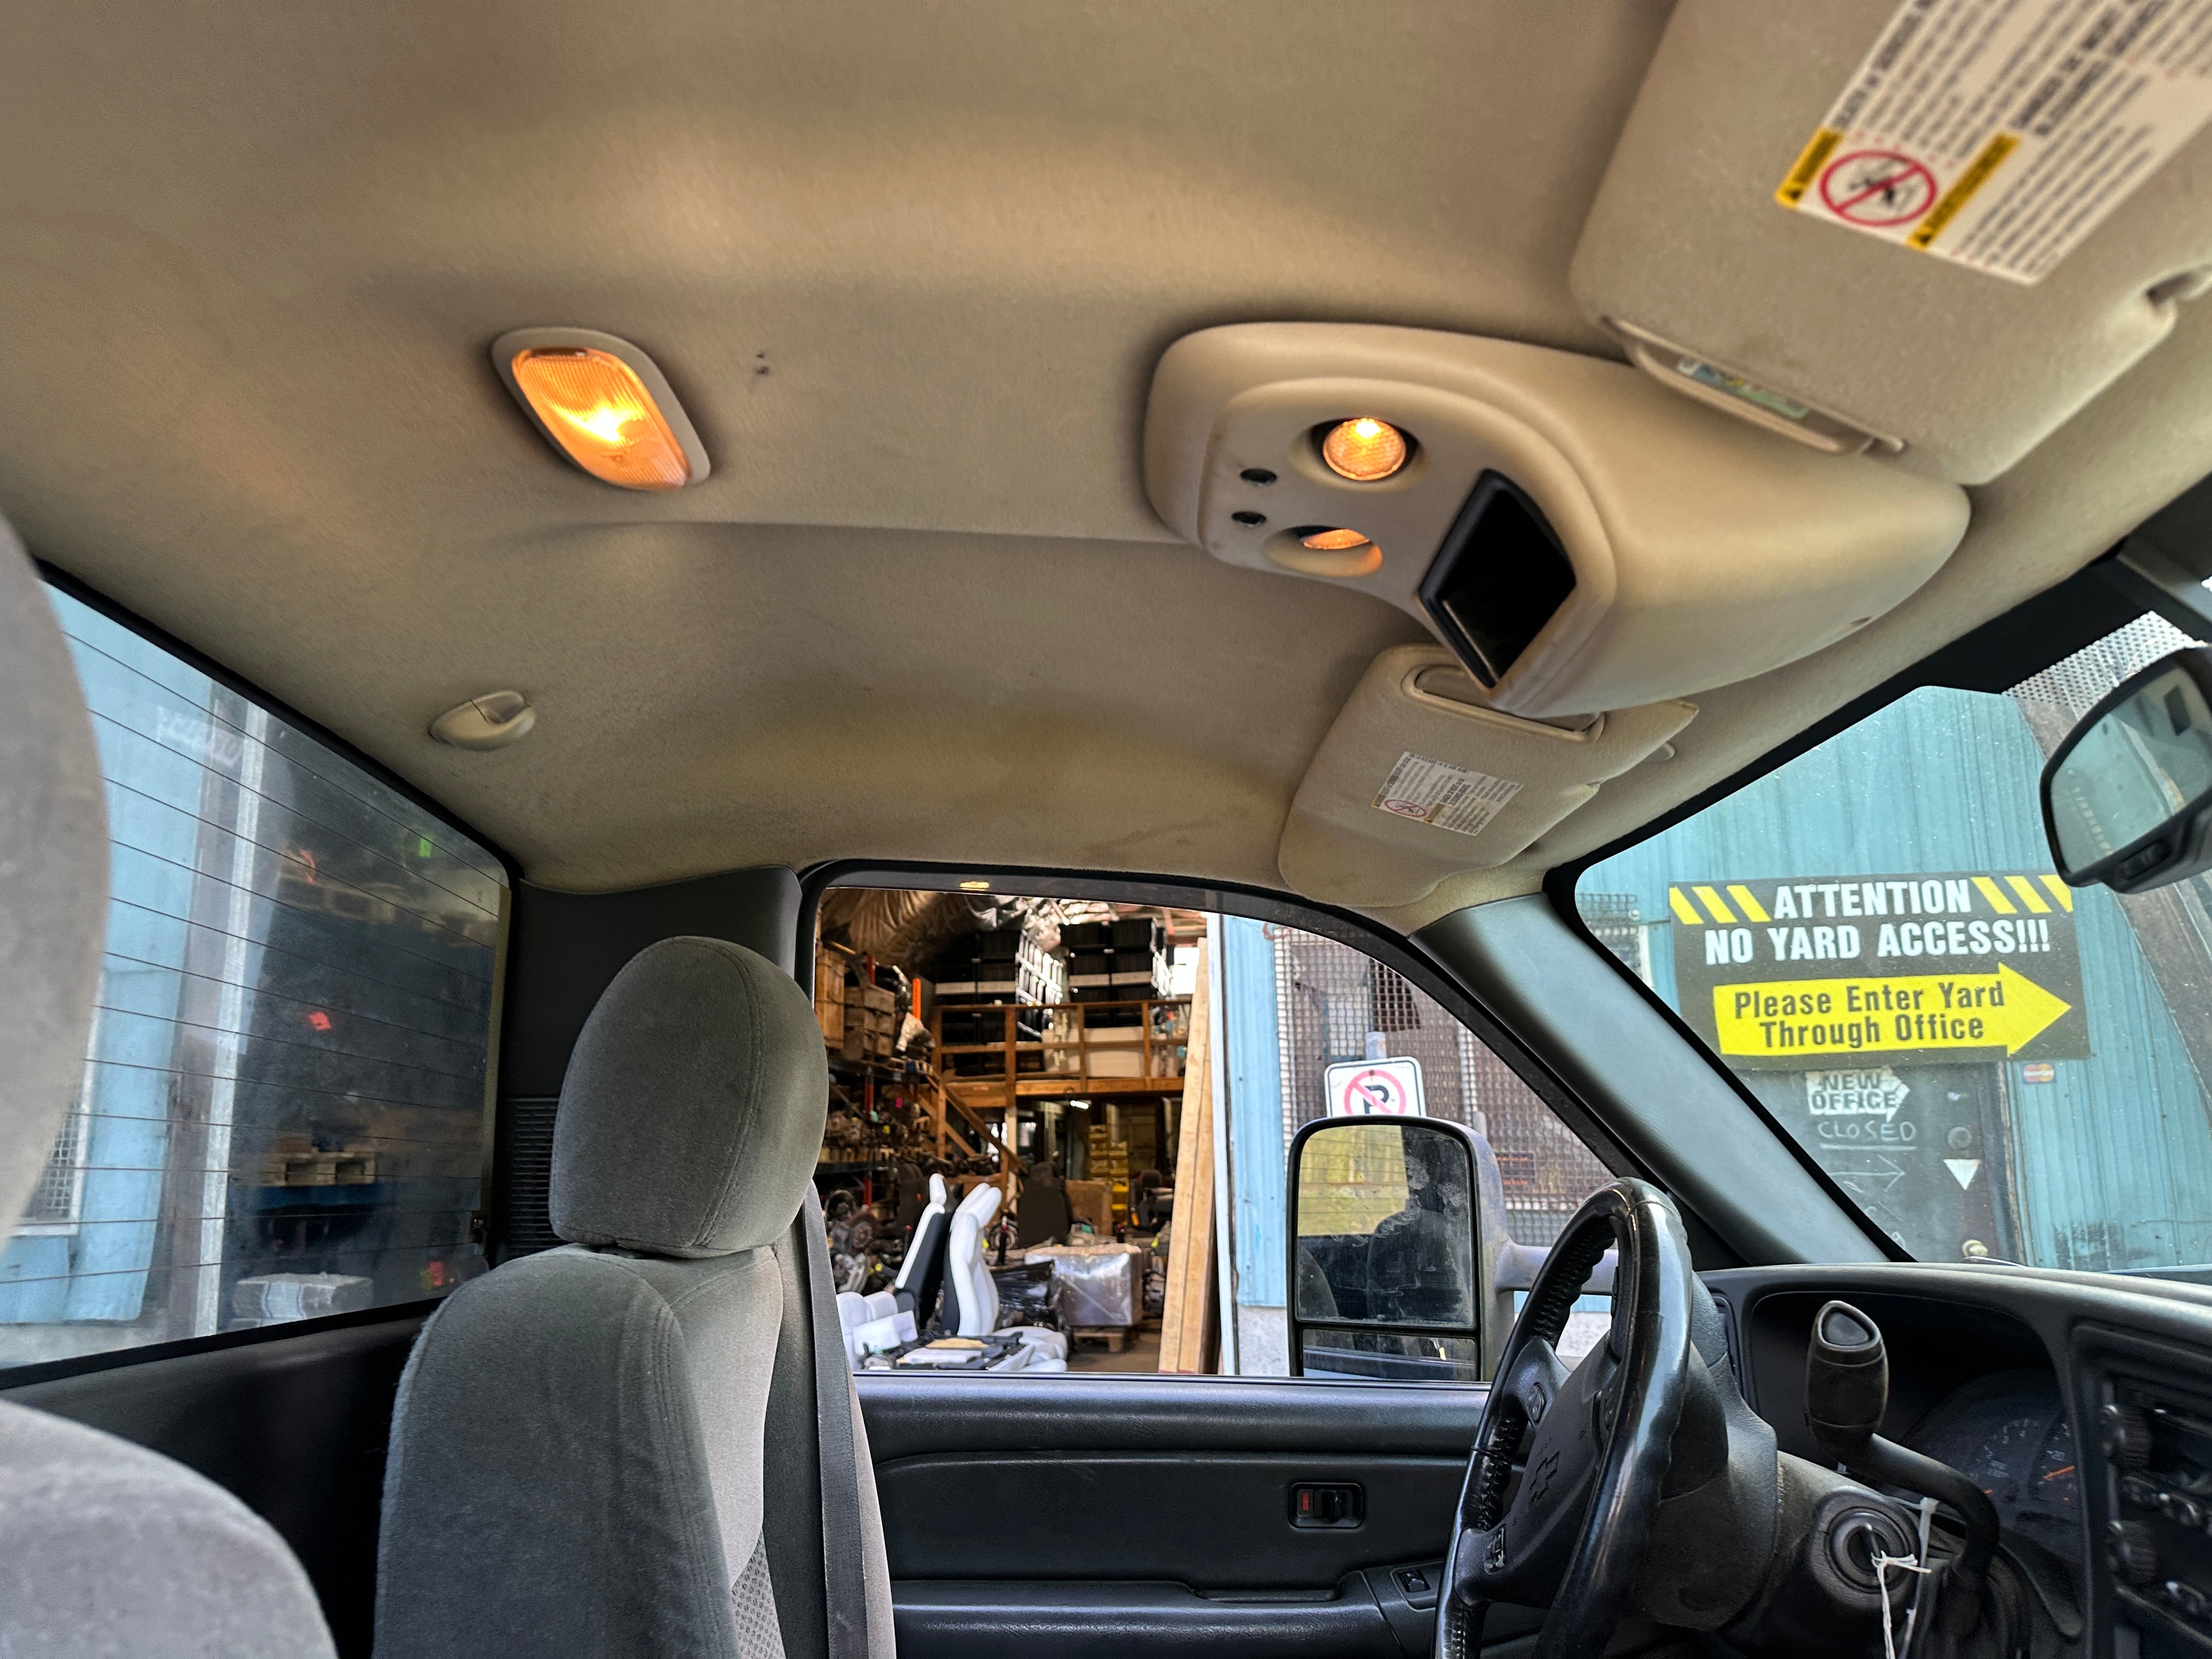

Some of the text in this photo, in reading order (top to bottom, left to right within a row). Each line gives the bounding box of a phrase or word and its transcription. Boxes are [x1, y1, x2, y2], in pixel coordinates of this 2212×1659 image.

[1774, 879, 1971, 919] ATTENTION
[1705, 919, 2050, 965] NO YARD ACCESS!!!
[1735, 980, 2004, 1019] Please Enter Yard
[1759, 1013, 1984, 1048] Through Office
[1823, 1073, 1881, 1090] NEW
[1812, 1090, 1897, 1109] OFFICE
[1817, 1120, 1916, 1141] CLOSED
